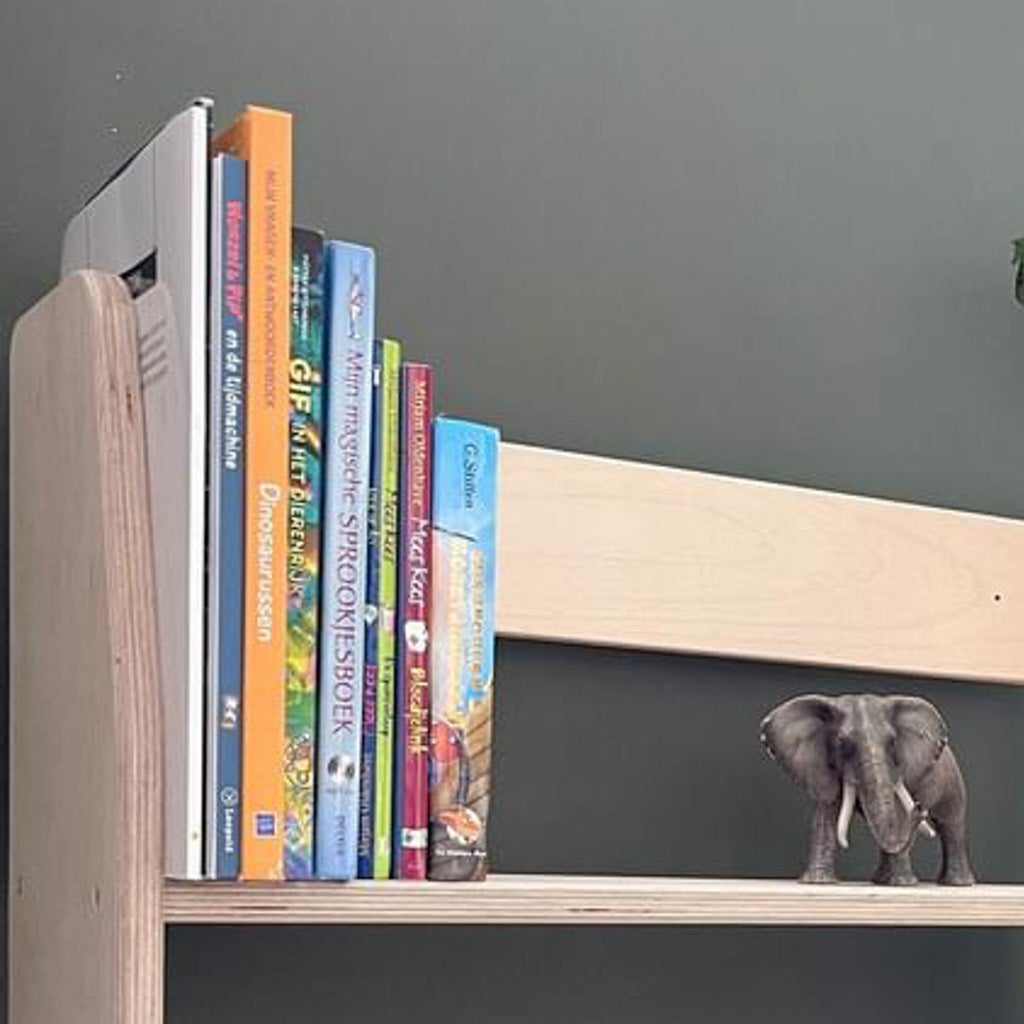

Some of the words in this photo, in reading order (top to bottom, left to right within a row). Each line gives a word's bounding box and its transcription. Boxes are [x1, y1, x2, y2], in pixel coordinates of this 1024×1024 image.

[225, 329, 241, 348] en
[226, 352, 241, 373] de
[289, 357, 312, 414] GIF
[342, 350, 365, 397] Mijn
[222, 376, 242, 470] tijdmachine
[410, 380, 428, 431] Mirjam
[291, 421, 306, 442] IN
[337, 405, 363, 505] magische
[290, 447, 306, 485] HET
[256, 482, 282, 643] Dinosaurussen
[288, 487, 307, 596] DIERENRIJK
[408, 517, 430, 564] Mees
[407, 566, 429, 609] Kees
[330, 512, 360, 736] SPROOKJESBOEK
